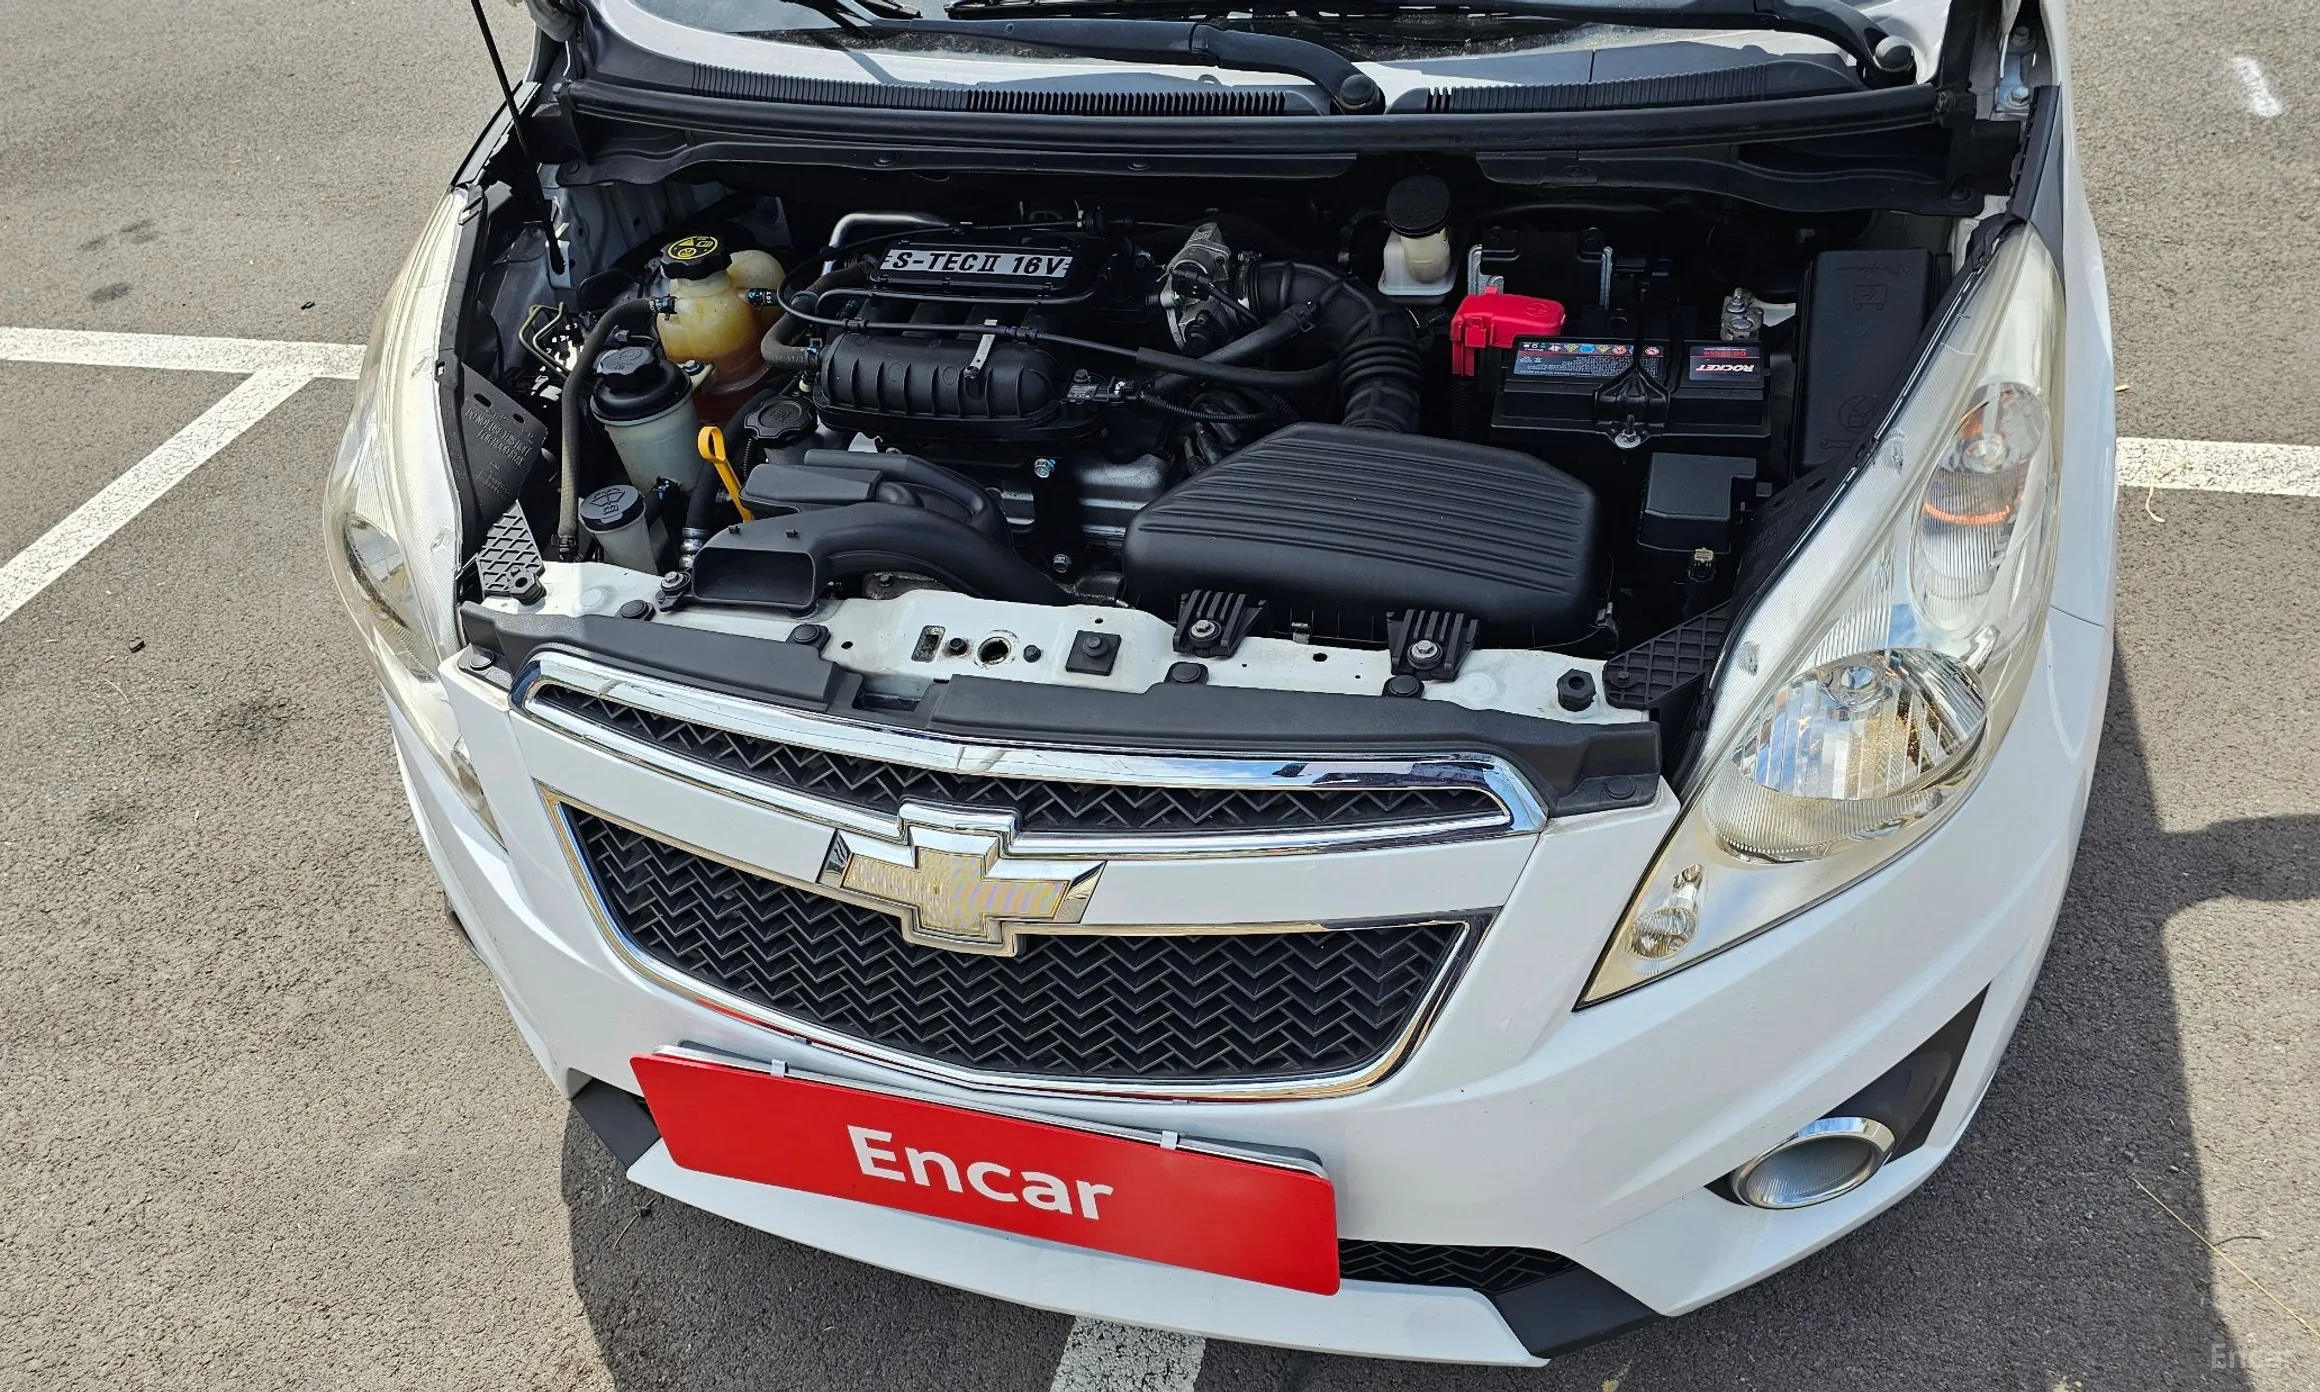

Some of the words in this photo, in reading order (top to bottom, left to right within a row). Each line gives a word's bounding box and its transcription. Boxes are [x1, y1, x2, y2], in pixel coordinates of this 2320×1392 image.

[1011, 256, 1065, 276] 16V
[1695, 364, 1755, 373] ROCKET
[846, 1125, 1113, 1220] Encar
